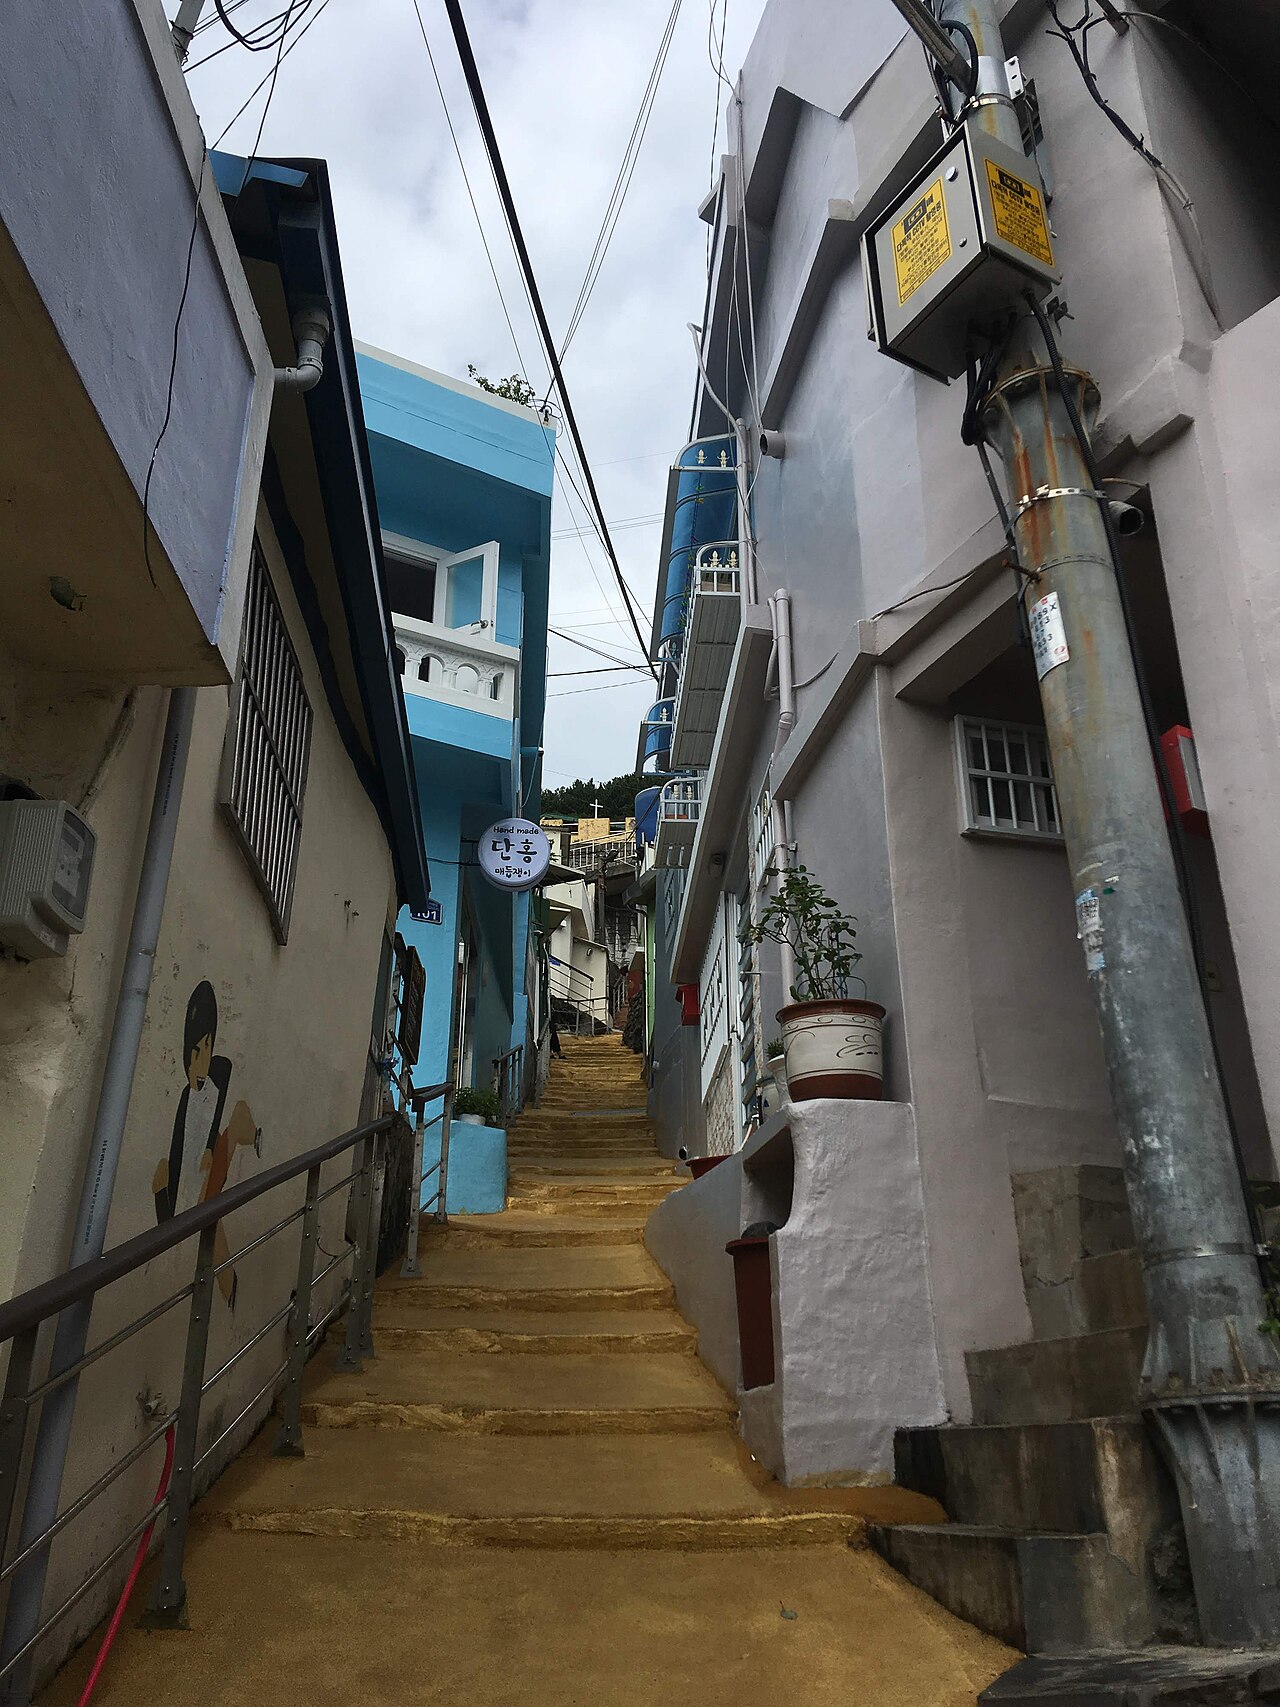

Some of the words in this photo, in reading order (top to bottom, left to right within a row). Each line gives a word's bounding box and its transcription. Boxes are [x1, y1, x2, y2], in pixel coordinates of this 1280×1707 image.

[912, 220, 925, 237] CCTV
[493, 826, 515, 834] Hand
[516, 827, 539, 835] made
